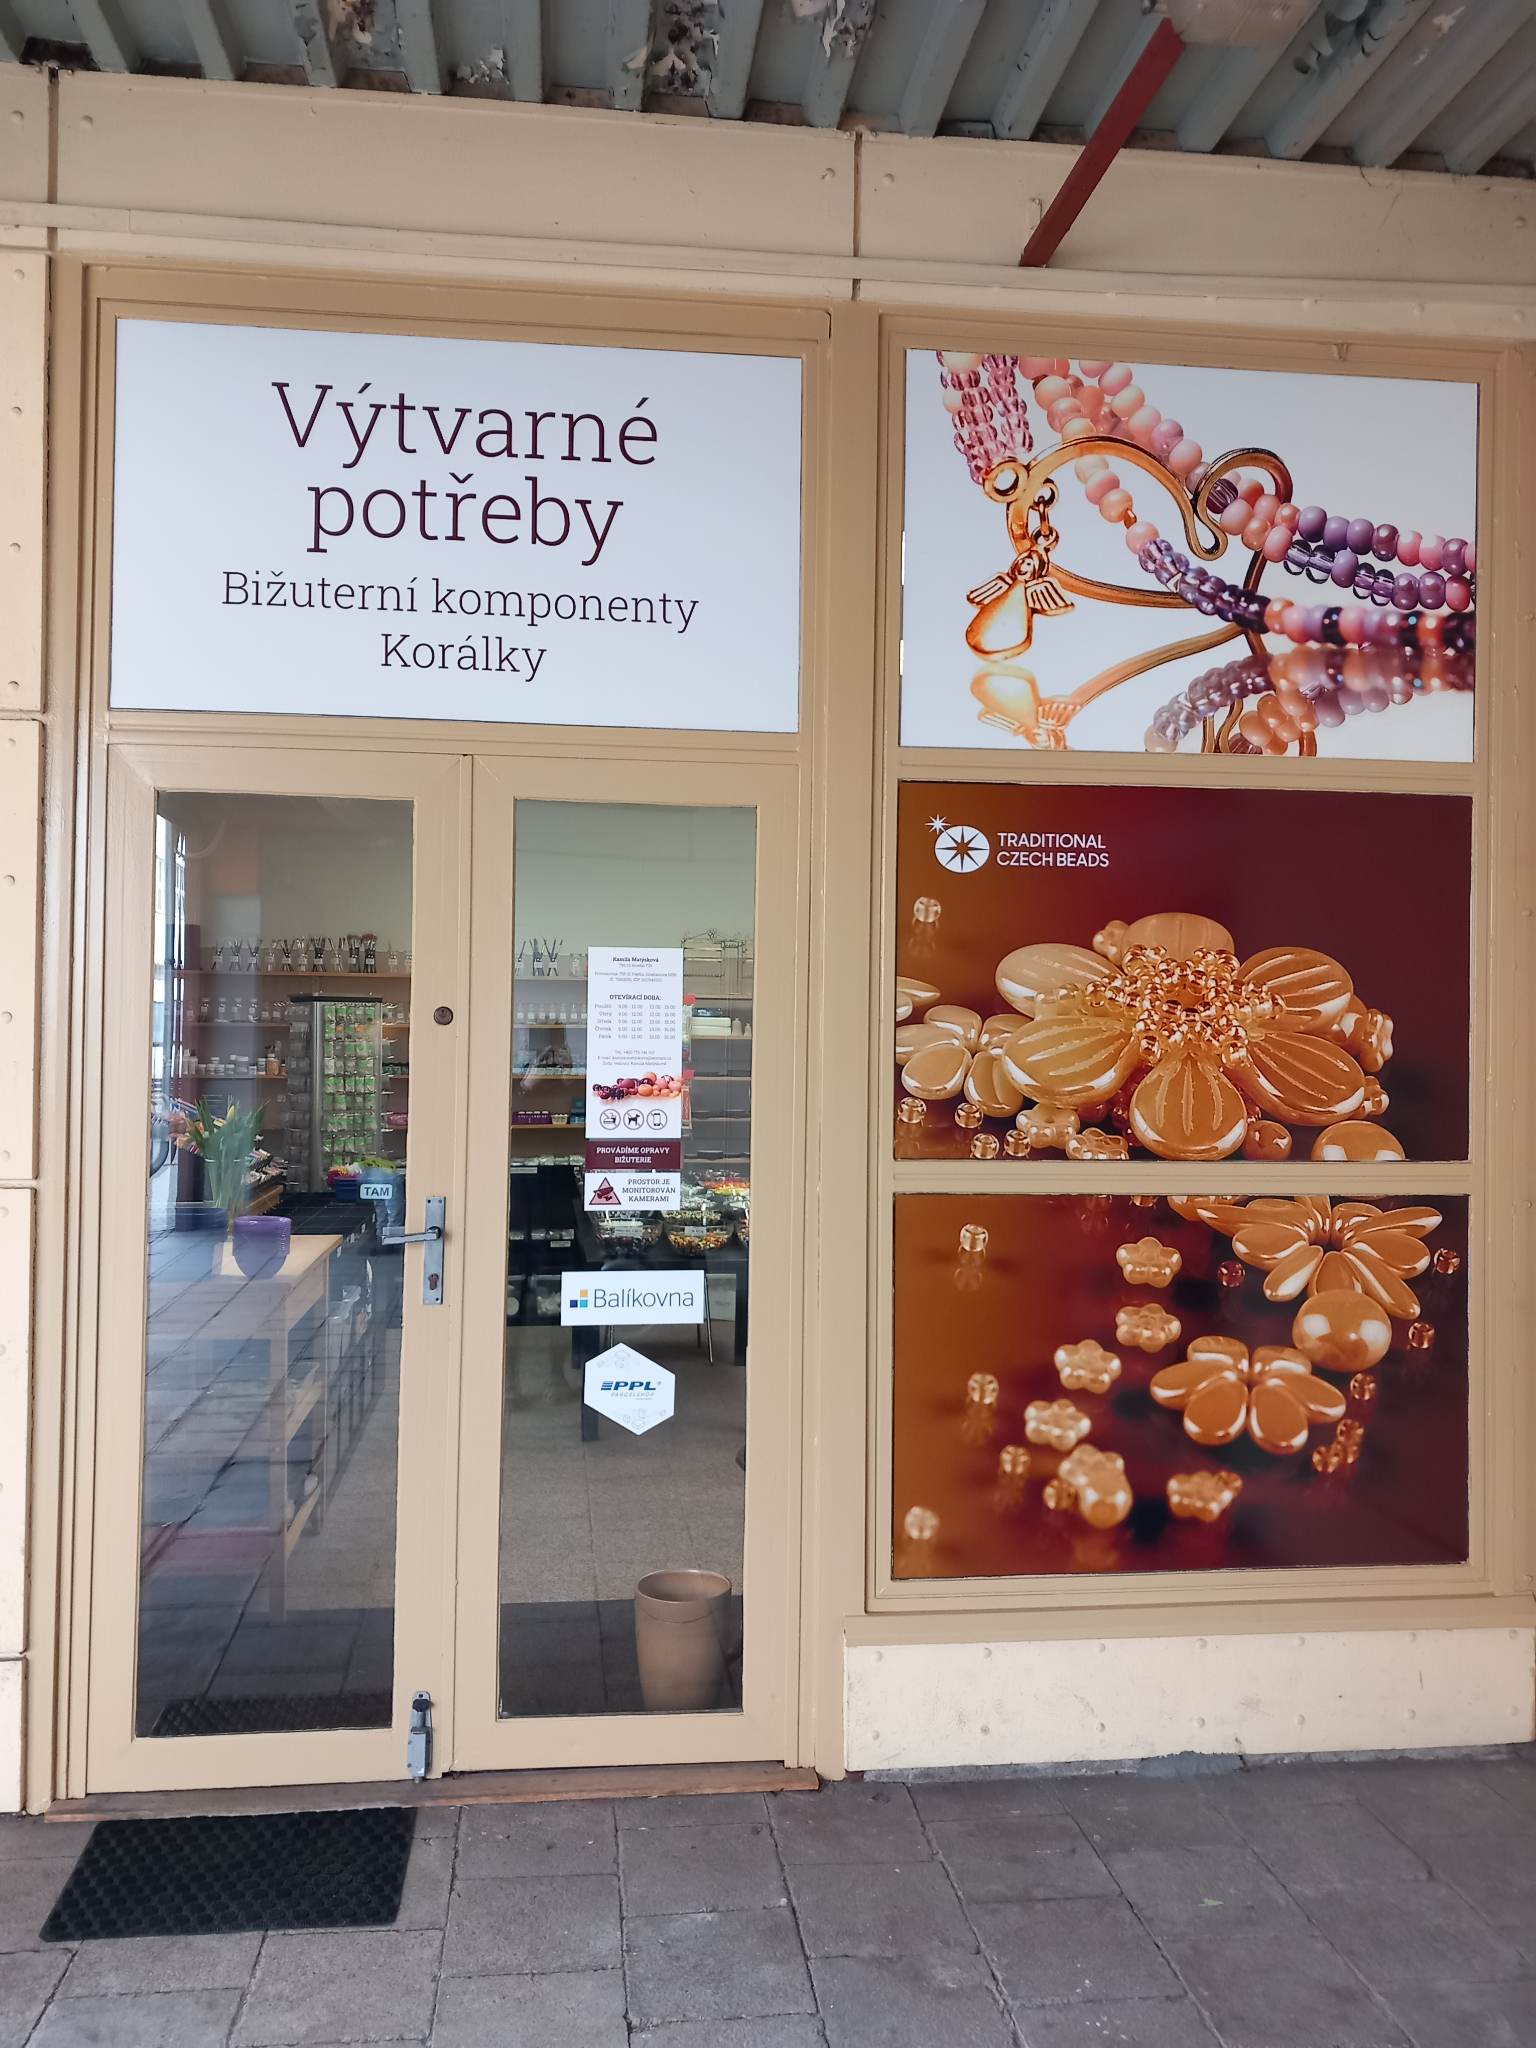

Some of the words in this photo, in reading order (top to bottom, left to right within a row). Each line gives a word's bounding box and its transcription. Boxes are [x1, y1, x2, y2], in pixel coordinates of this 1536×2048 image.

[272, 381, 658, 469] Výtvarné
[306, 473, 624, 566] potřeby
[222, 571, 418, 614] Bižuterní
[432, 578, 700, 634] komponenty
[380, 633, 548, 682] Korálky
[997, 832, 1107, 849] TRADITIONAL
[996, 851, 1053, 867] CZECH
[1056, 852, 1110, 868] BEADS
[596, 1145, 640, 1154] PROVÁDÍME
[640, 1146, 670, 1154] OPRAVY
[614, 1155, 652, 1163] BIŽUTERIE
[364, 1187, 390, 1197] TAM
[628, 1195, 669, 1203] KAMERAMI
[594, 1288, 694, 1308] Balíkovna
[611, 1380, 657, 1391] PPL
